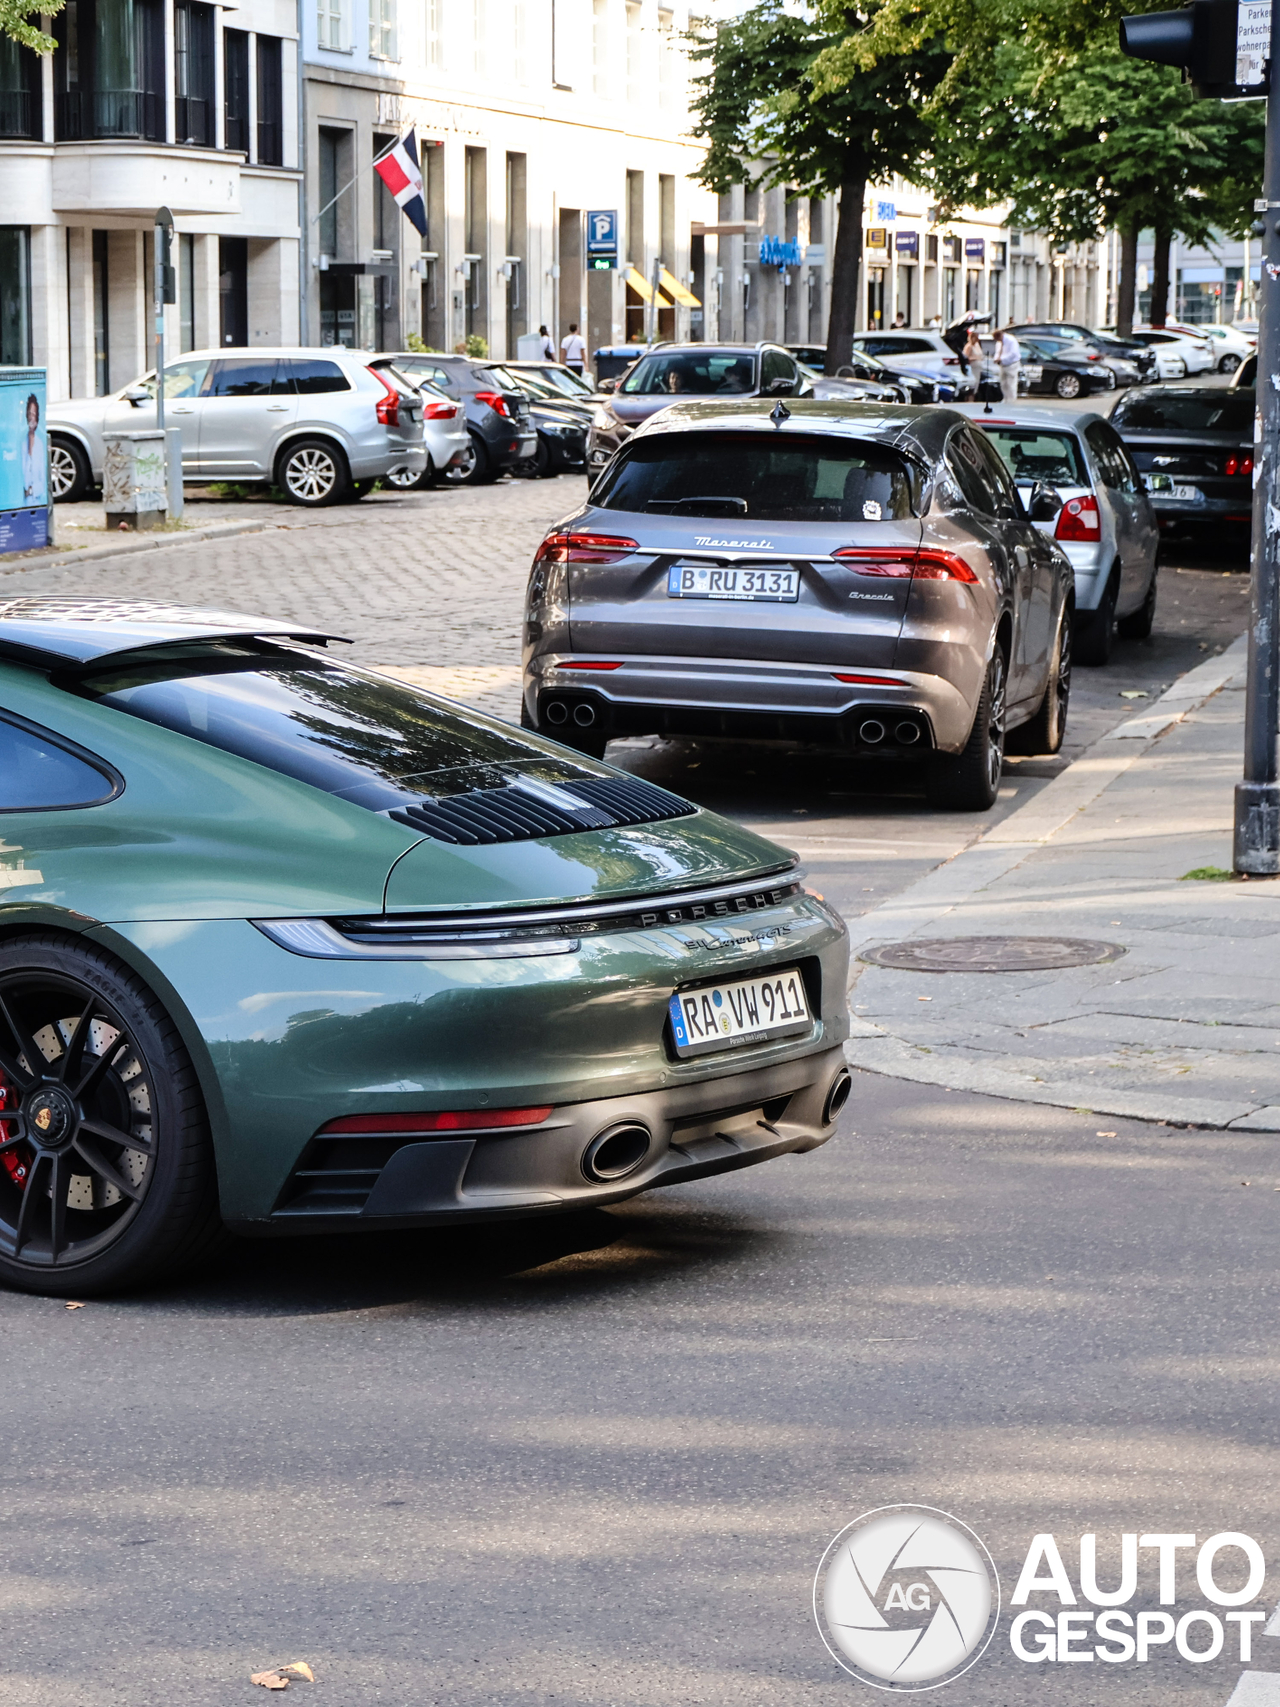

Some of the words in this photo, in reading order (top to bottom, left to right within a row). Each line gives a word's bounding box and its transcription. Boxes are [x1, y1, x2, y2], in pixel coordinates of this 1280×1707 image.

[596, 220, 610, 241] P
[694, 536, 775, 550] Maserati
[681, 570, 695, 590] B
[709, 571, 737, 591] RU
[742, 572, 794, 594] 3131
[642, 892, 782, 926] PORSCHE
[83, 969, 126, 1007] EAGLE
[683, 994, 719, 1039] RA
[727, 984, 760, 1029] VW
[761, 977, 805, 1022] 911
[676, 1027, 684, 1039] D
